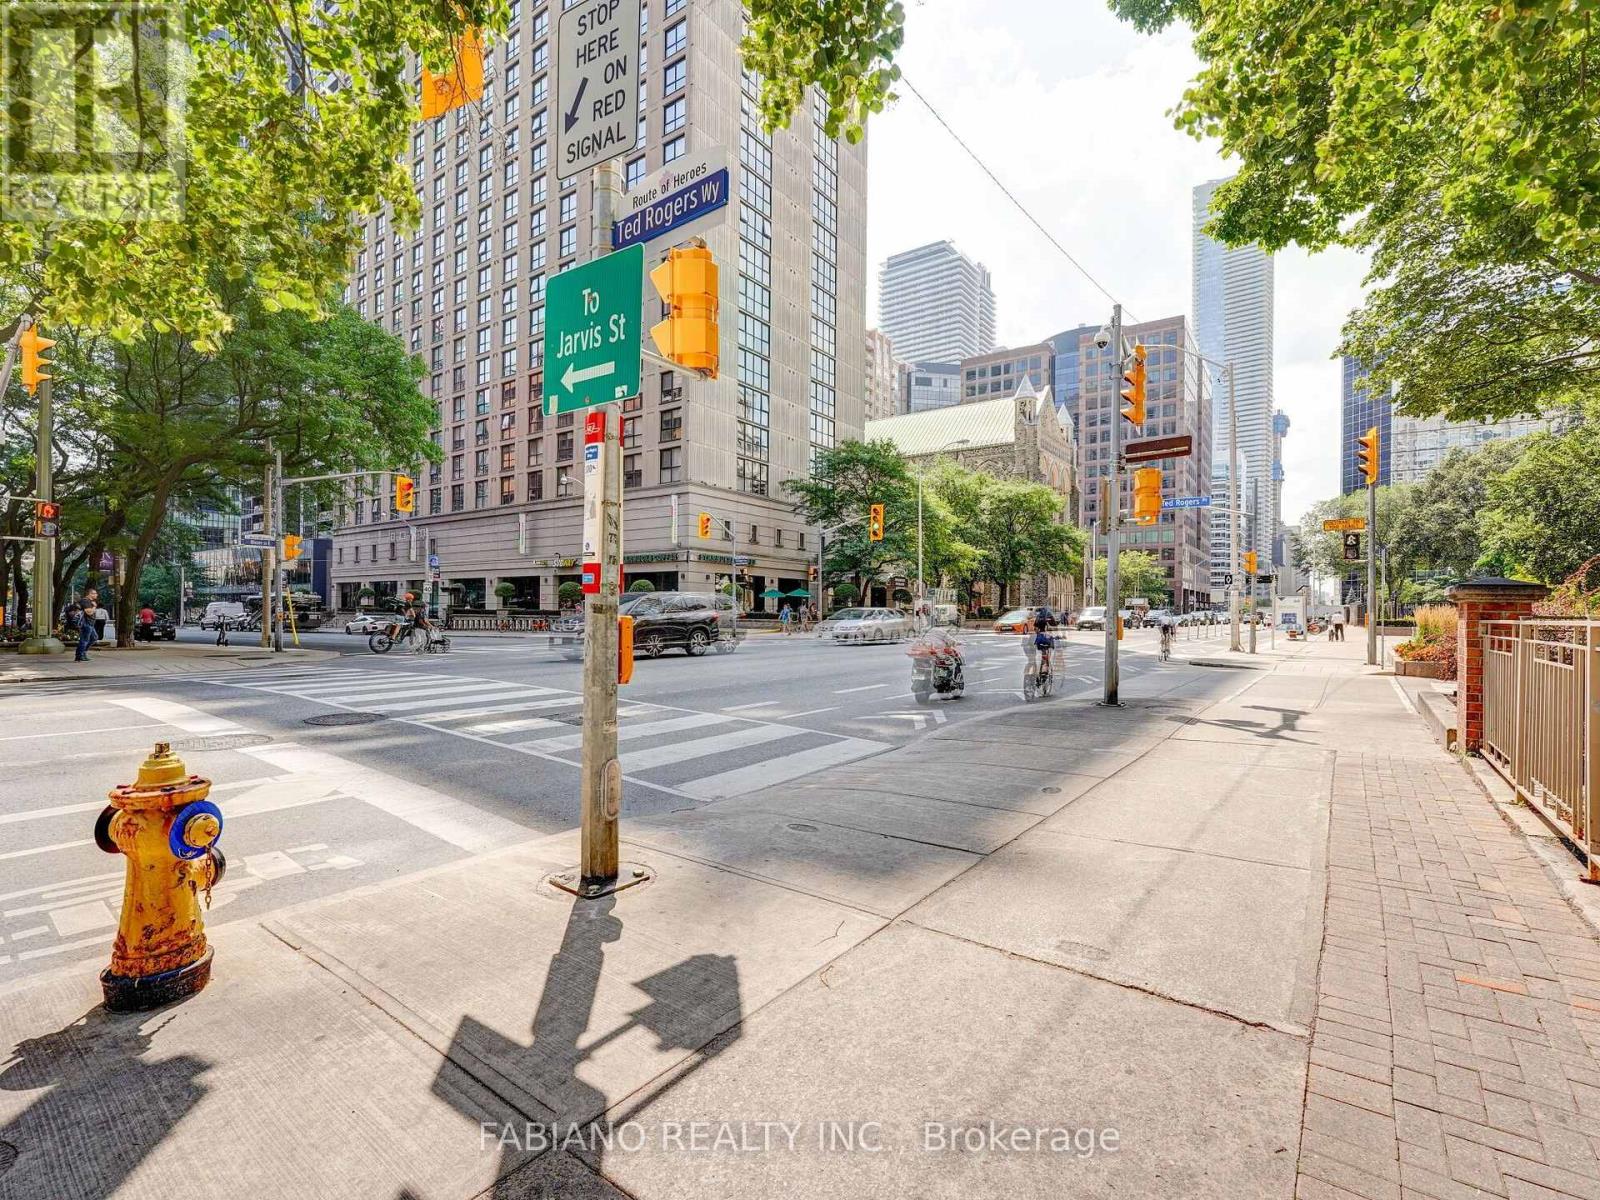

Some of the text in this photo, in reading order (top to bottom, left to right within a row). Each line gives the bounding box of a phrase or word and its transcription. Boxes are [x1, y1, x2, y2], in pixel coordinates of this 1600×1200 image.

[577, 0, 619, 36] STOP
[576, 28, 619, 68] HERE
[604, 55, 627, 84] ON
[593, 89, 626, 121] RED
[567, 122, 626, 163] SIGNAL
[632, 162, 707, 209] Route of Heroes
[617, 180, 720, 243] Ted Rogers Wy
[582, 288, 600, 316] To
[557, 313, 626, 359] Jarvis St
[1175, 499, 1201, 507] Rogers
